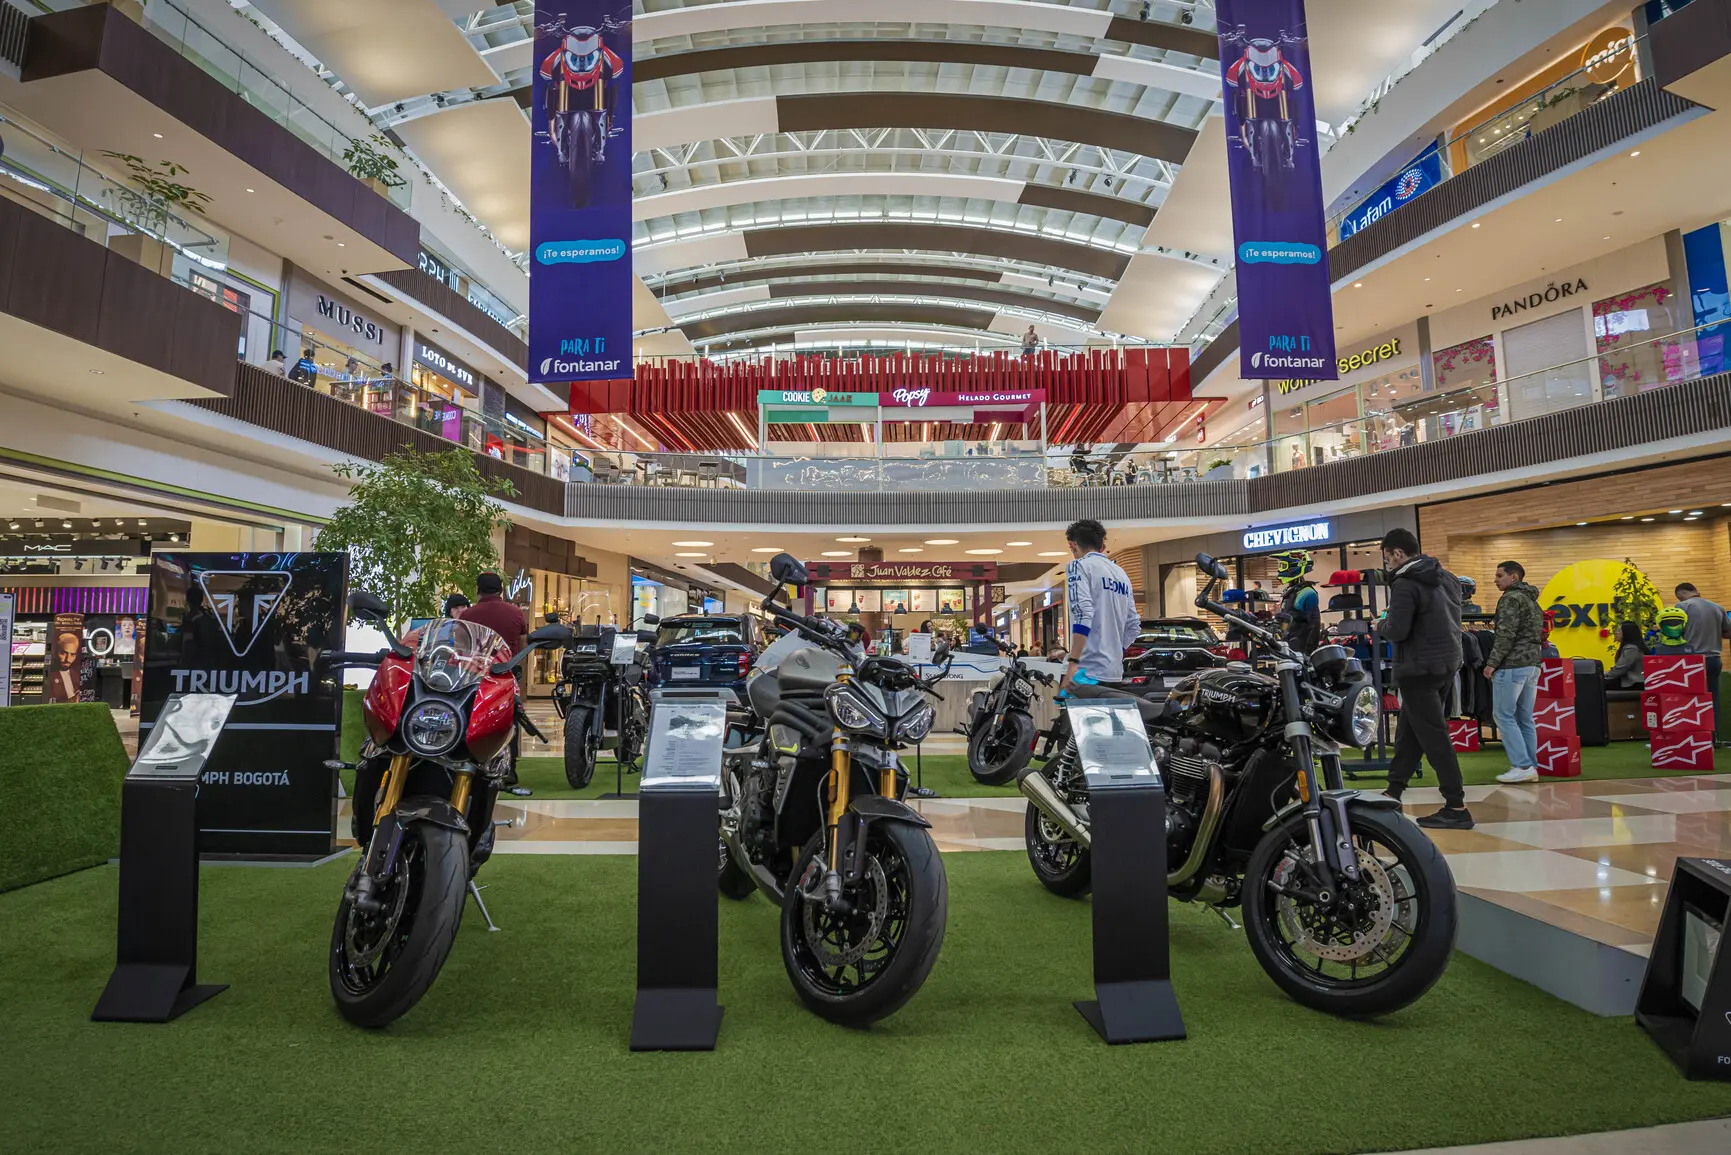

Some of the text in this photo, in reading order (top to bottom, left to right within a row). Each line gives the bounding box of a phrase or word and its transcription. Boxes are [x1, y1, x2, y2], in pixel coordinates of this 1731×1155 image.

[1353, 196, 1392, 234] Lafam
[543, 246, 620, 259] ¡Te esperamos!
[1245, 248, 1316, 259] ¡Te esperamos!
[418, 252, 445, 283] RPH
[1491, 278, 1588, 320] PANDORA
[317, 295, 384, 345] MUSSI
[422, 345, 446, 368] LOTO
[1264, 354, 1325, 368] fontanar
[554, 359, 621, 373] fontanar
[782, 391, 810, 403] COOKIE
[892, 387, 931, 407] Popsy
[1243, 522, 1330, 548] CHEVIGNON
[867, 564, 895, 577] Juan
[932, 565, 952, 577] Café
[1101, 577, 1129, 597] LEONA
[170, 669, 309, 701] TRIUMPH
[1201, 689, 1236, 702] TRIUMPH
[201, 769, 290, 786] MPH BOGOTÁ
[1717, 1056, 1731, 1065] FO
